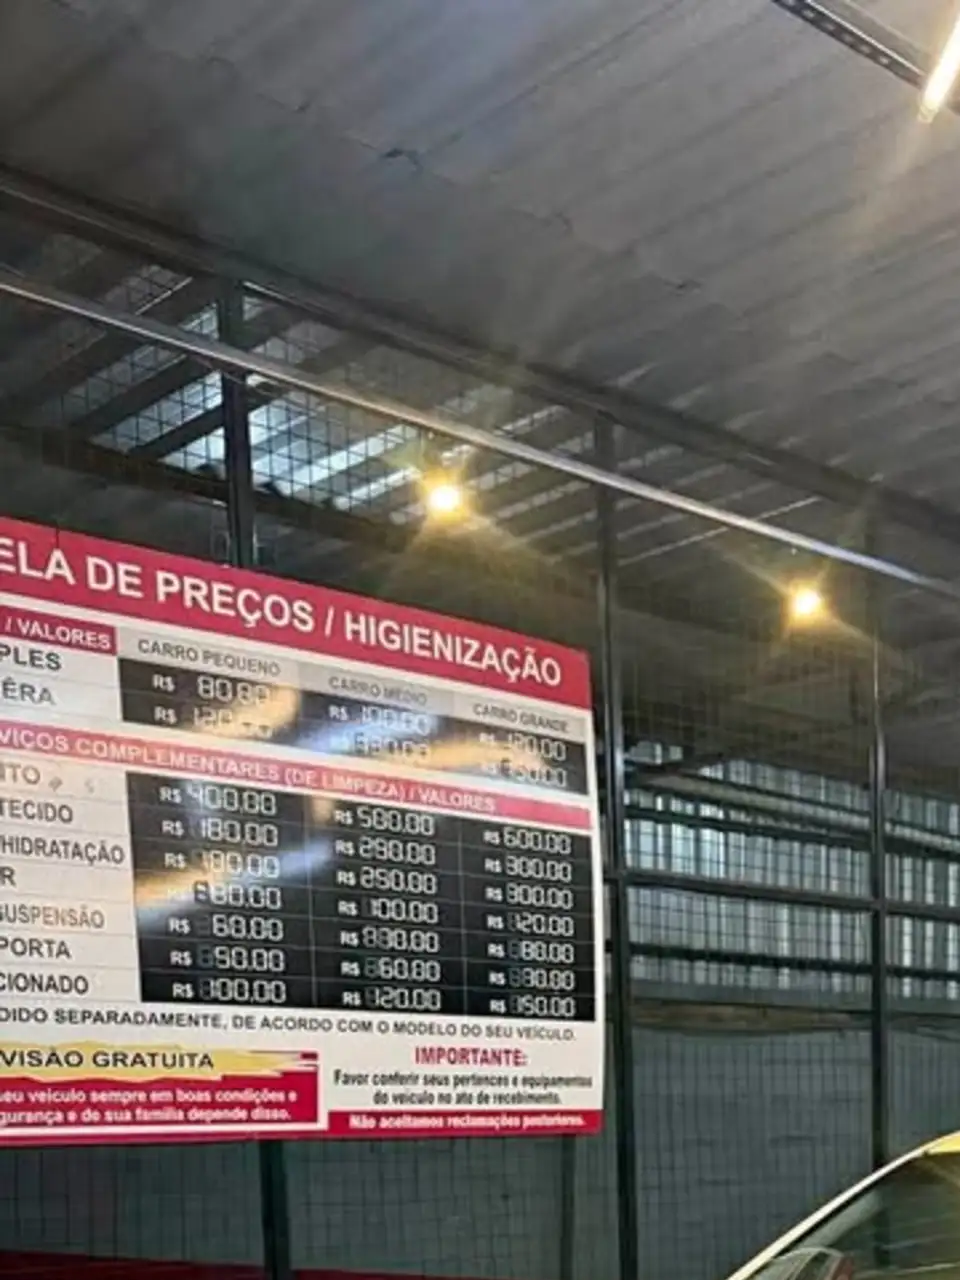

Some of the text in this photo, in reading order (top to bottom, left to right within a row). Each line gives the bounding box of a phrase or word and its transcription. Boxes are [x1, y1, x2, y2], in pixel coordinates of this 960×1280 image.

[86, 555, 143, 598] DE
[156, 570, 314, 632] PREÇOS
[325, 606, 335, 638] /
[344, 610, 561, 686] HIGIENIZAÇÃO
[17, 617, 111, 650] VALORES
[138, 639, 281, 678] CARRO PEQUENO
[152, 673, 176, 692] R$
[154, 705, 178, 725] R$
[75, 737, 279, 781] COMPLEMENTARES
[417, 784, 497, 812] VALORES
[159, 785, 181, 804] R$
[335, 809, 353, 825] R$
[162, 820, 184, 837] R$
[484, 831, 500, 845] R$
[336, 839, 355, 856] R$
[165, 852, 187, 869] R$
[485, 858, 502, 874] R$
[337, 870, 357, 887] R$
[486, 886, 504, 902] R$
[338, 900, 357, 916] R$
[169, 918, 190, 934] R$
[487, 915, 504, 930] R$
[340, 930, 359, 947] R$
[170, 951, 192, 966] R$
[340, 961, 360, 977] R$
[172, 983, 194, 999] R$
[342, 991, 361, 1006] R$
[54, 1008, 228, 1030] SEPARADAMENTE,
[232, 1014, 256, 1030] DE
[260, 1015, 333, 1033] ACORDO
[337, 1019, 372, 1034] COM
[378, 1020, 389, 1034] O
[393, 1021, 456, 1037] MODELO
[461, 1024, 481, 1038] DO
[485, 1024, 512, 1039] SEU
[92, 1050, 214, 1070] GRATUITA
[415, 1046, 528, 1067] IMPORTANTE:
[334, 1069, 369, 1086] Favor
[372, 1071, 419, 1086] conferir
[423, 1073, 450, 1087] seus
[453, 1074, 509, 1089] pertences
[89, 1089, 147, 1106] sempre
[150, 1089, 174, 1103] em
[176, 1087, 211, 1103] boas
[215, 1087, 285, 1105] condições
[288, 1090, 297, 1103] e
[67, 1110, 78, 1122] e
[104, 1109, 132, 1123] sua
[187, 1106, 248, 1124] depende
